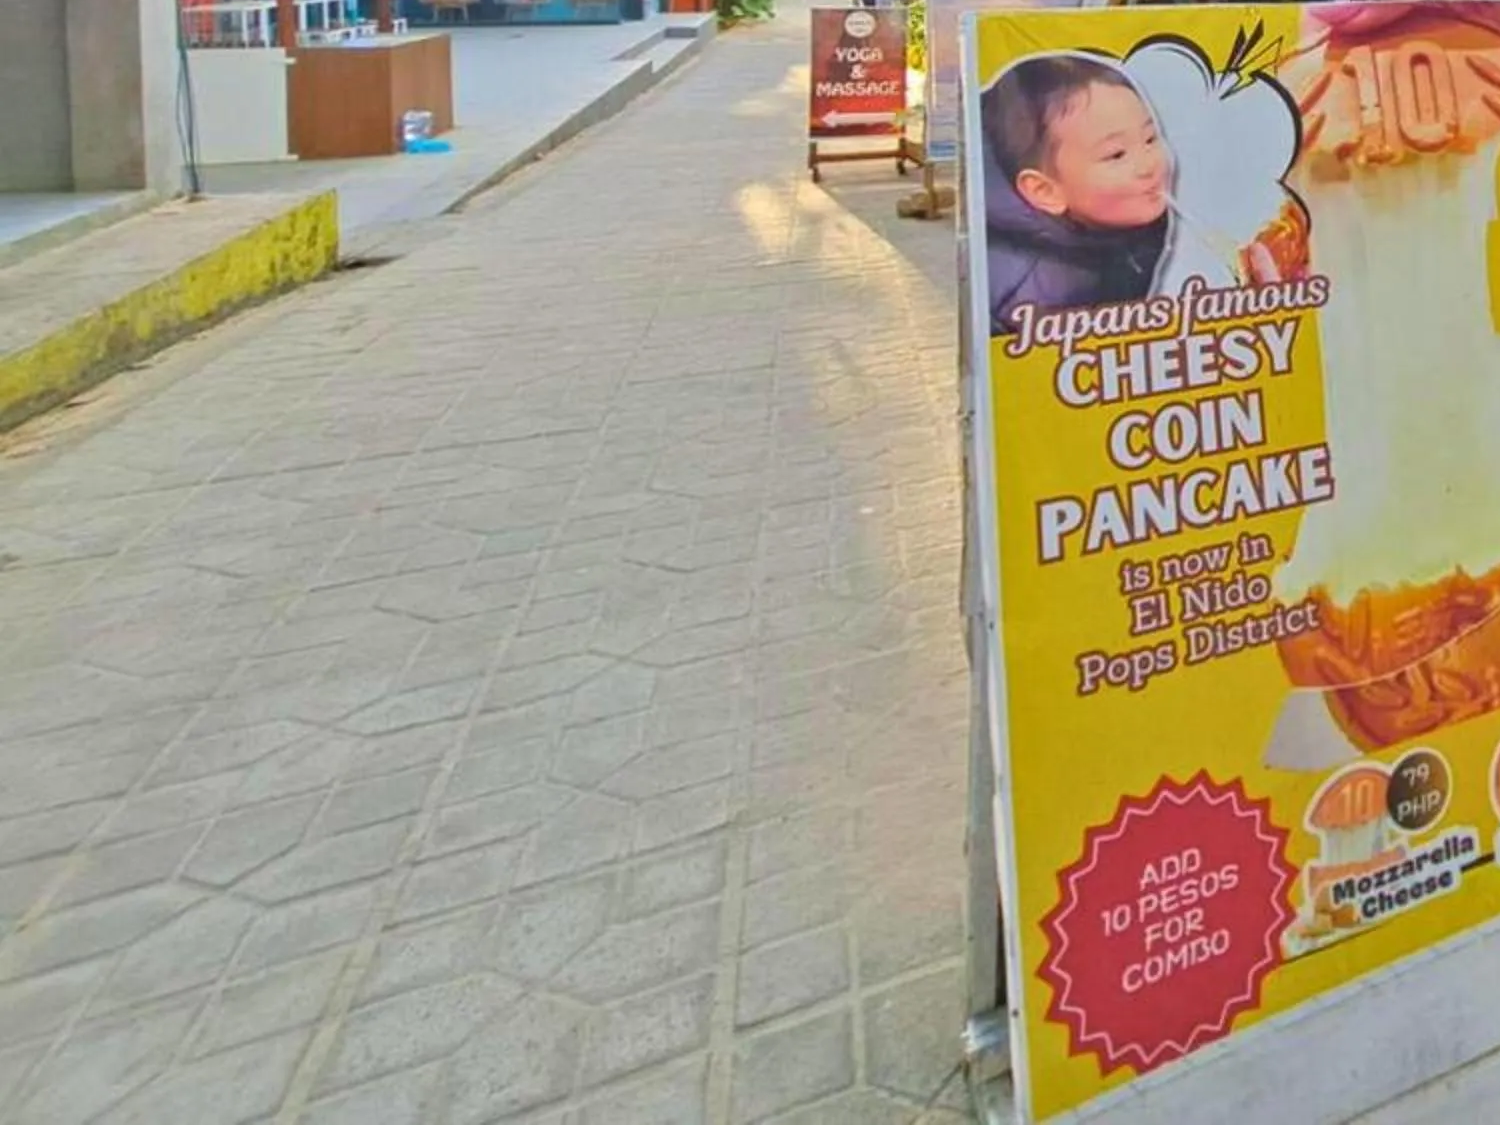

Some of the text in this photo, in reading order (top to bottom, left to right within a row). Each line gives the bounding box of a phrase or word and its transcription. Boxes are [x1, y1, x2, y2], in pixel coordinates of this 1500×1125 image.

[835, 47, 883, 63] YOGA
[849, 63, 866, 80] &
[816, 79, 901, 97] MASSAGE
[1004, 274, 1329, 358] Japans famous
[1054, 317, 1301, 409] CHEESY
[1107, 388, 1266, 470] COIN
[1036, 442, 1336, 565] PANCAKE
[1121, 532, 1275, 594] is now in
[1129, 571, 1273, 636] El Nido
[1076, 597, 1322, 696] Pops District
[1396, 789, 1442, 822] PHP
[1401, 762, 1431, 787] 79
[1101, 863, 1240, 936] 10 PESOS
[1139, 847, 1201, 891] ADD
[1331, 833, 1477, 906] Mozzarella
[1360, 869, 1456, 921] Cheese
[1144, 907, 1206, 952] FOR
[1121, 929, 1231, 994] COMBO
